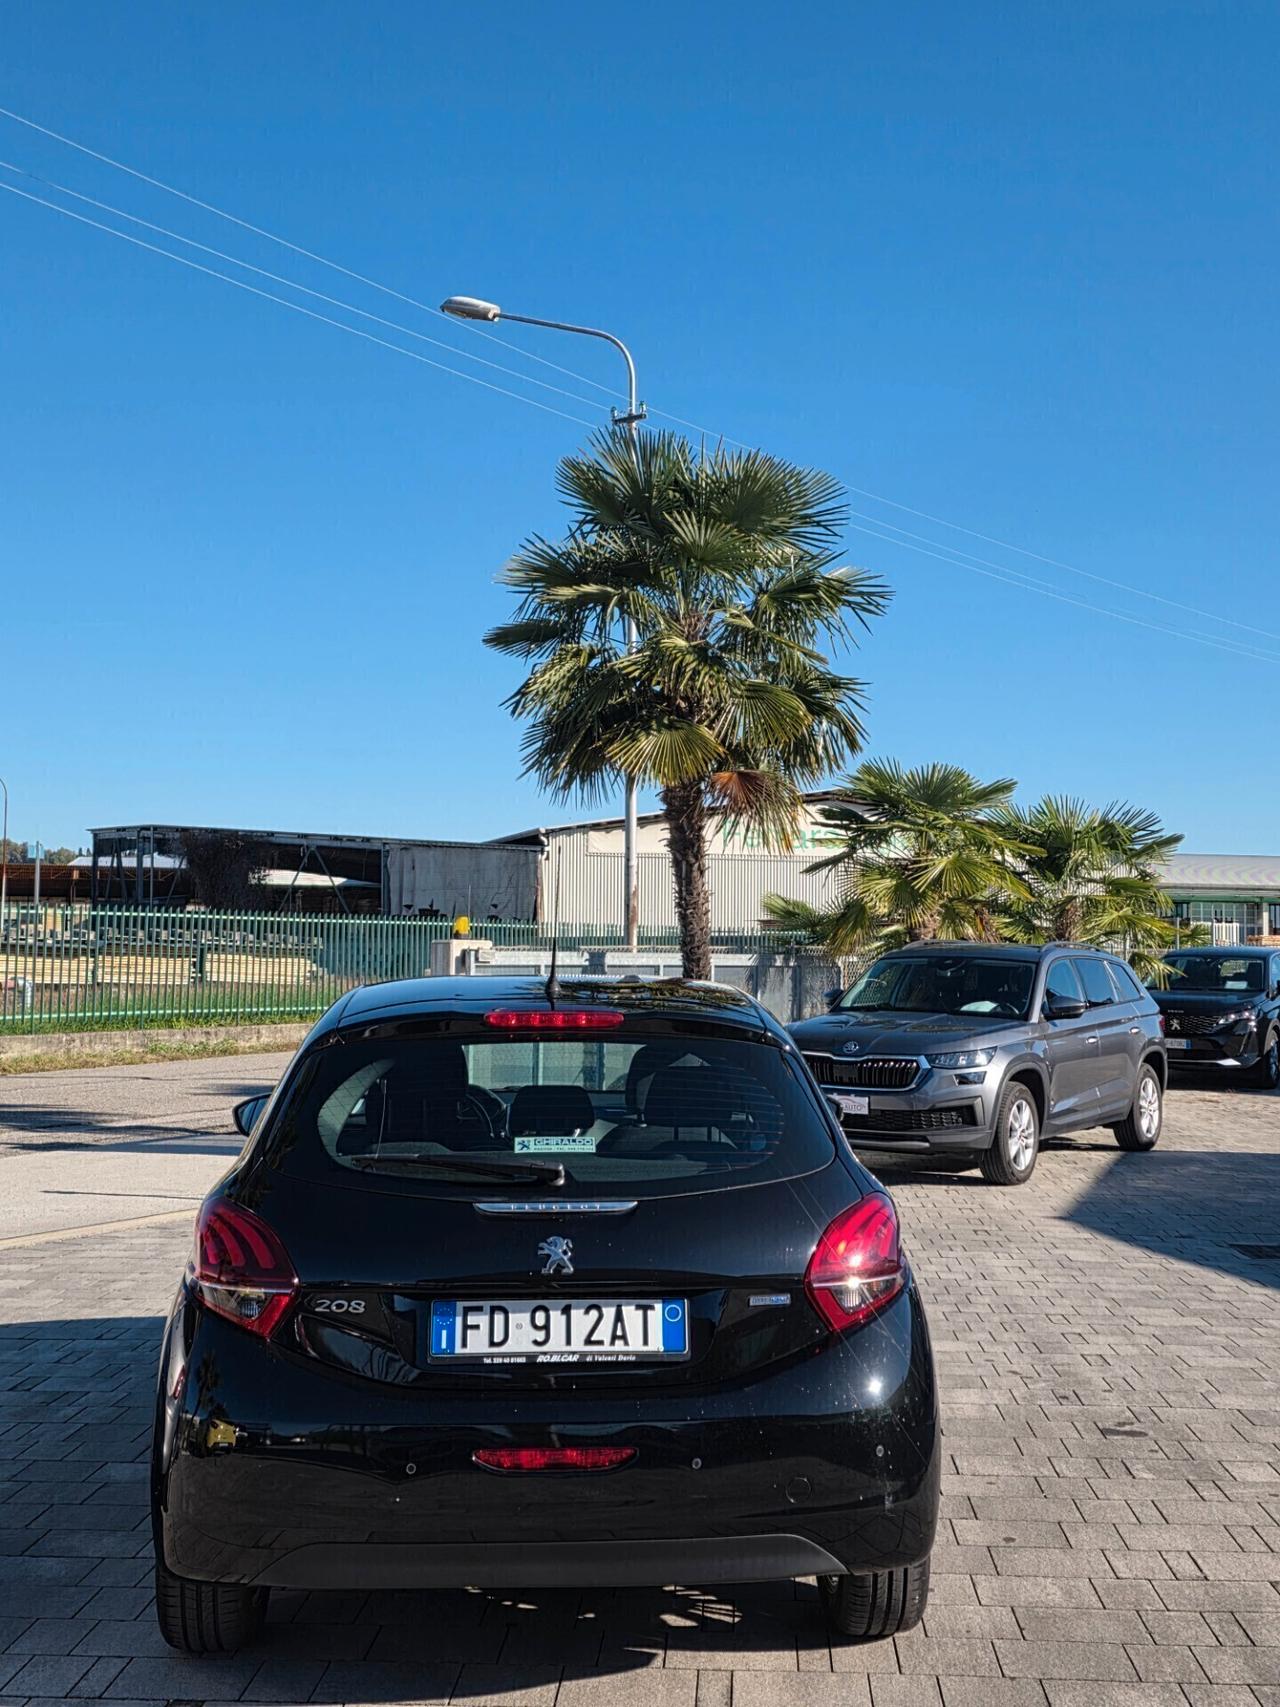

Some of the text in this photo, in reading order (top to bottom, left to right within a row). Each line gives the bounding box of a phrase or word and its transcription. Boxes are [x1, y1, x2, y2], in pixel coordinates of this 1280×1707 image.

[315, 1299, 366, 1313] 208
[461, 1304, 510, 1349] FD
[530, 1303, 656, 1347] 912AT
